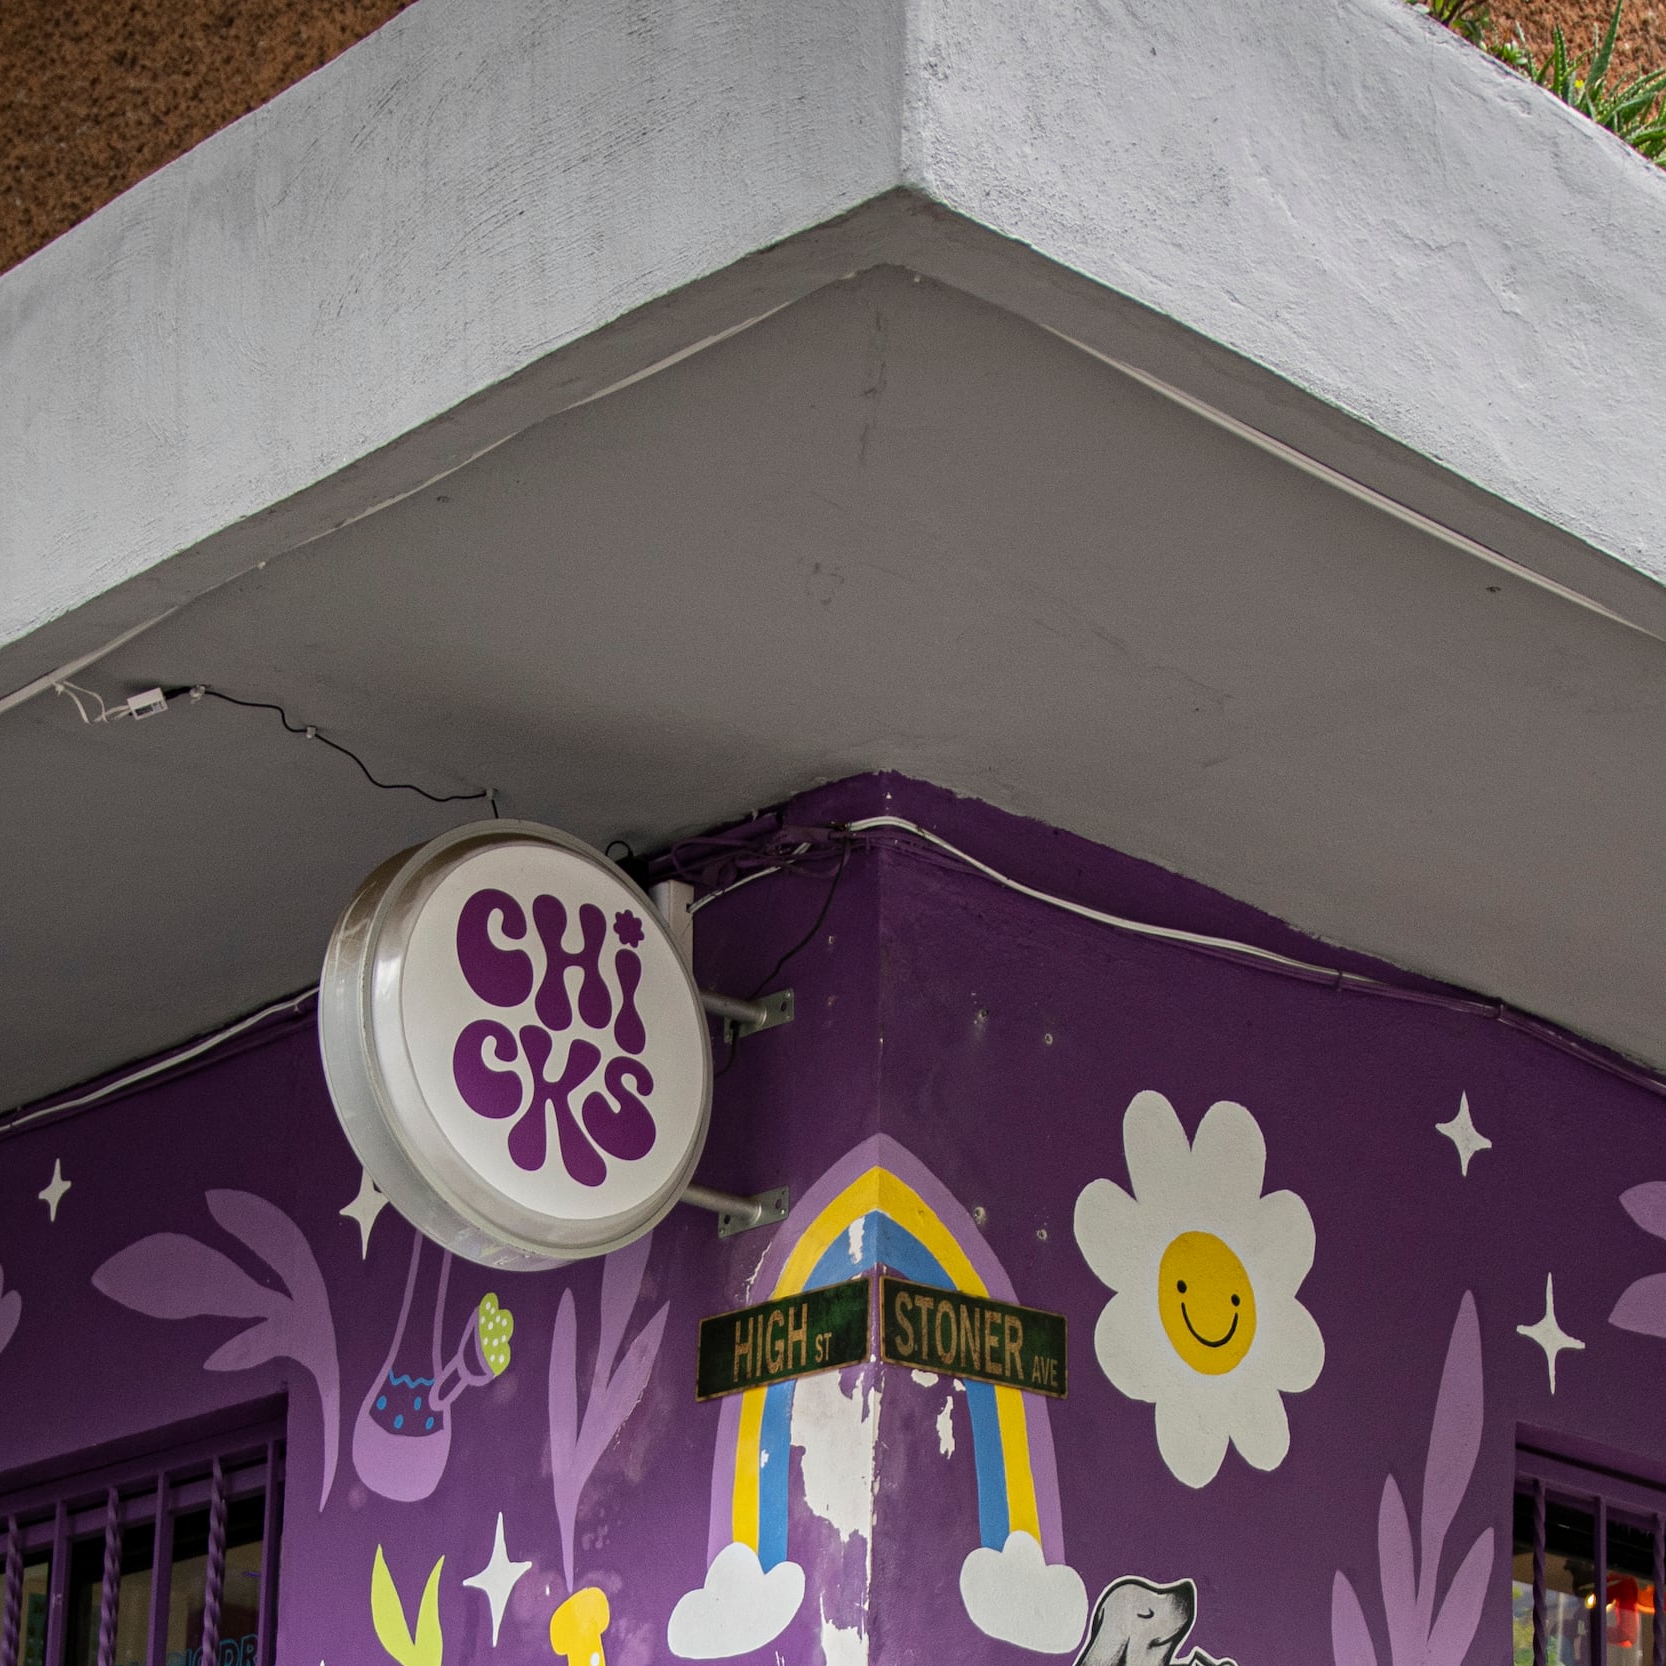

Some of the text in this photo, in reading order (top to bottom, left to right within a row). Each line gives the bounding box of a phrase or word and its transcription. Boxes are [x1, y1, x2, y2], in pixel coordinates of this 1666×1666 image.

[453, 1019, 657, 1187] CKS
[733, 1303, 833, 1383] HIGH ST
[894, 1291, 1059, 1388] STONER AVE
